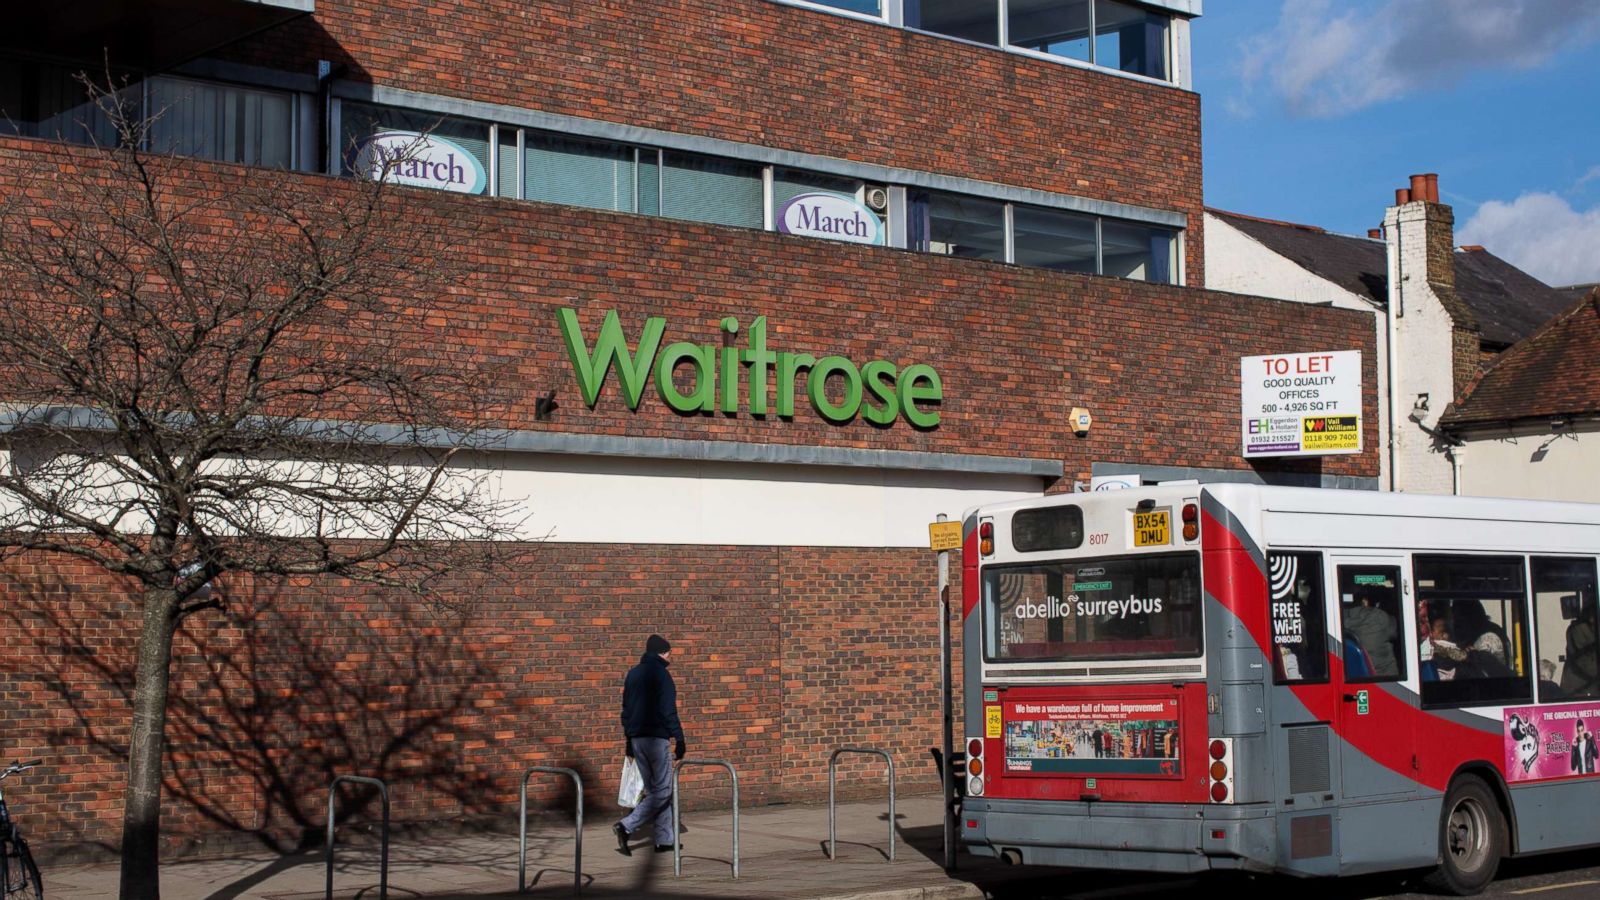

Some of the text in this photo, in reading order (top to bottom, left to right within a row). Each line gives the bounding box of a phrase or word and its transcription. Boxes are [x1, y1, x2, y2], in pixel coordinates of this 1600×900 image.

[370, 144, 466, 185] March
[796, 204, 869, 238] March
[556, 307, 943, 429] Waitrose
[1263, 355, 1333, 375] TO LET
[1263, 376, 1336, 389] GOOD QUALITY
[1279, 389, 1319, 400] OFFICES
[1262, 404, 1277, 413] 500
[1284, 402, 1308, 413] 4,926
[1310, 401, 1324, 411] SQ
[1326, 400, 1338, 410] FT
[1136, 513, 1166, 528] BX54
[1089, 533, 1109, 545] 8017
[1141, 529, 1163, 544] DMU
[1015, 594, 1163, 619] abellio surreybus
[1272, 602, 1301, 618] FREE
[1273, 618, 1302, 635] Wi-Fi
[1274, 635, 1302, 643] ONBOARD
[1015, 704, 1025, 713] We
[1026, 704, 1040, 713] have
[1047, 704, 1080, 713] warehouse
[1081, 703, 1092, 713] full
[1093, 703, 1100, 712] of
[1101, 703, 1119, 712] home
[1120, 702, 1164, 714] improvement
[1543, 712, 1553, 720] THE
[1554, 710, 1578, 719] ORIGINAL
[1579, 709, 1592, 718] WEST
[1546, 741, 1570, 754] PARKER
